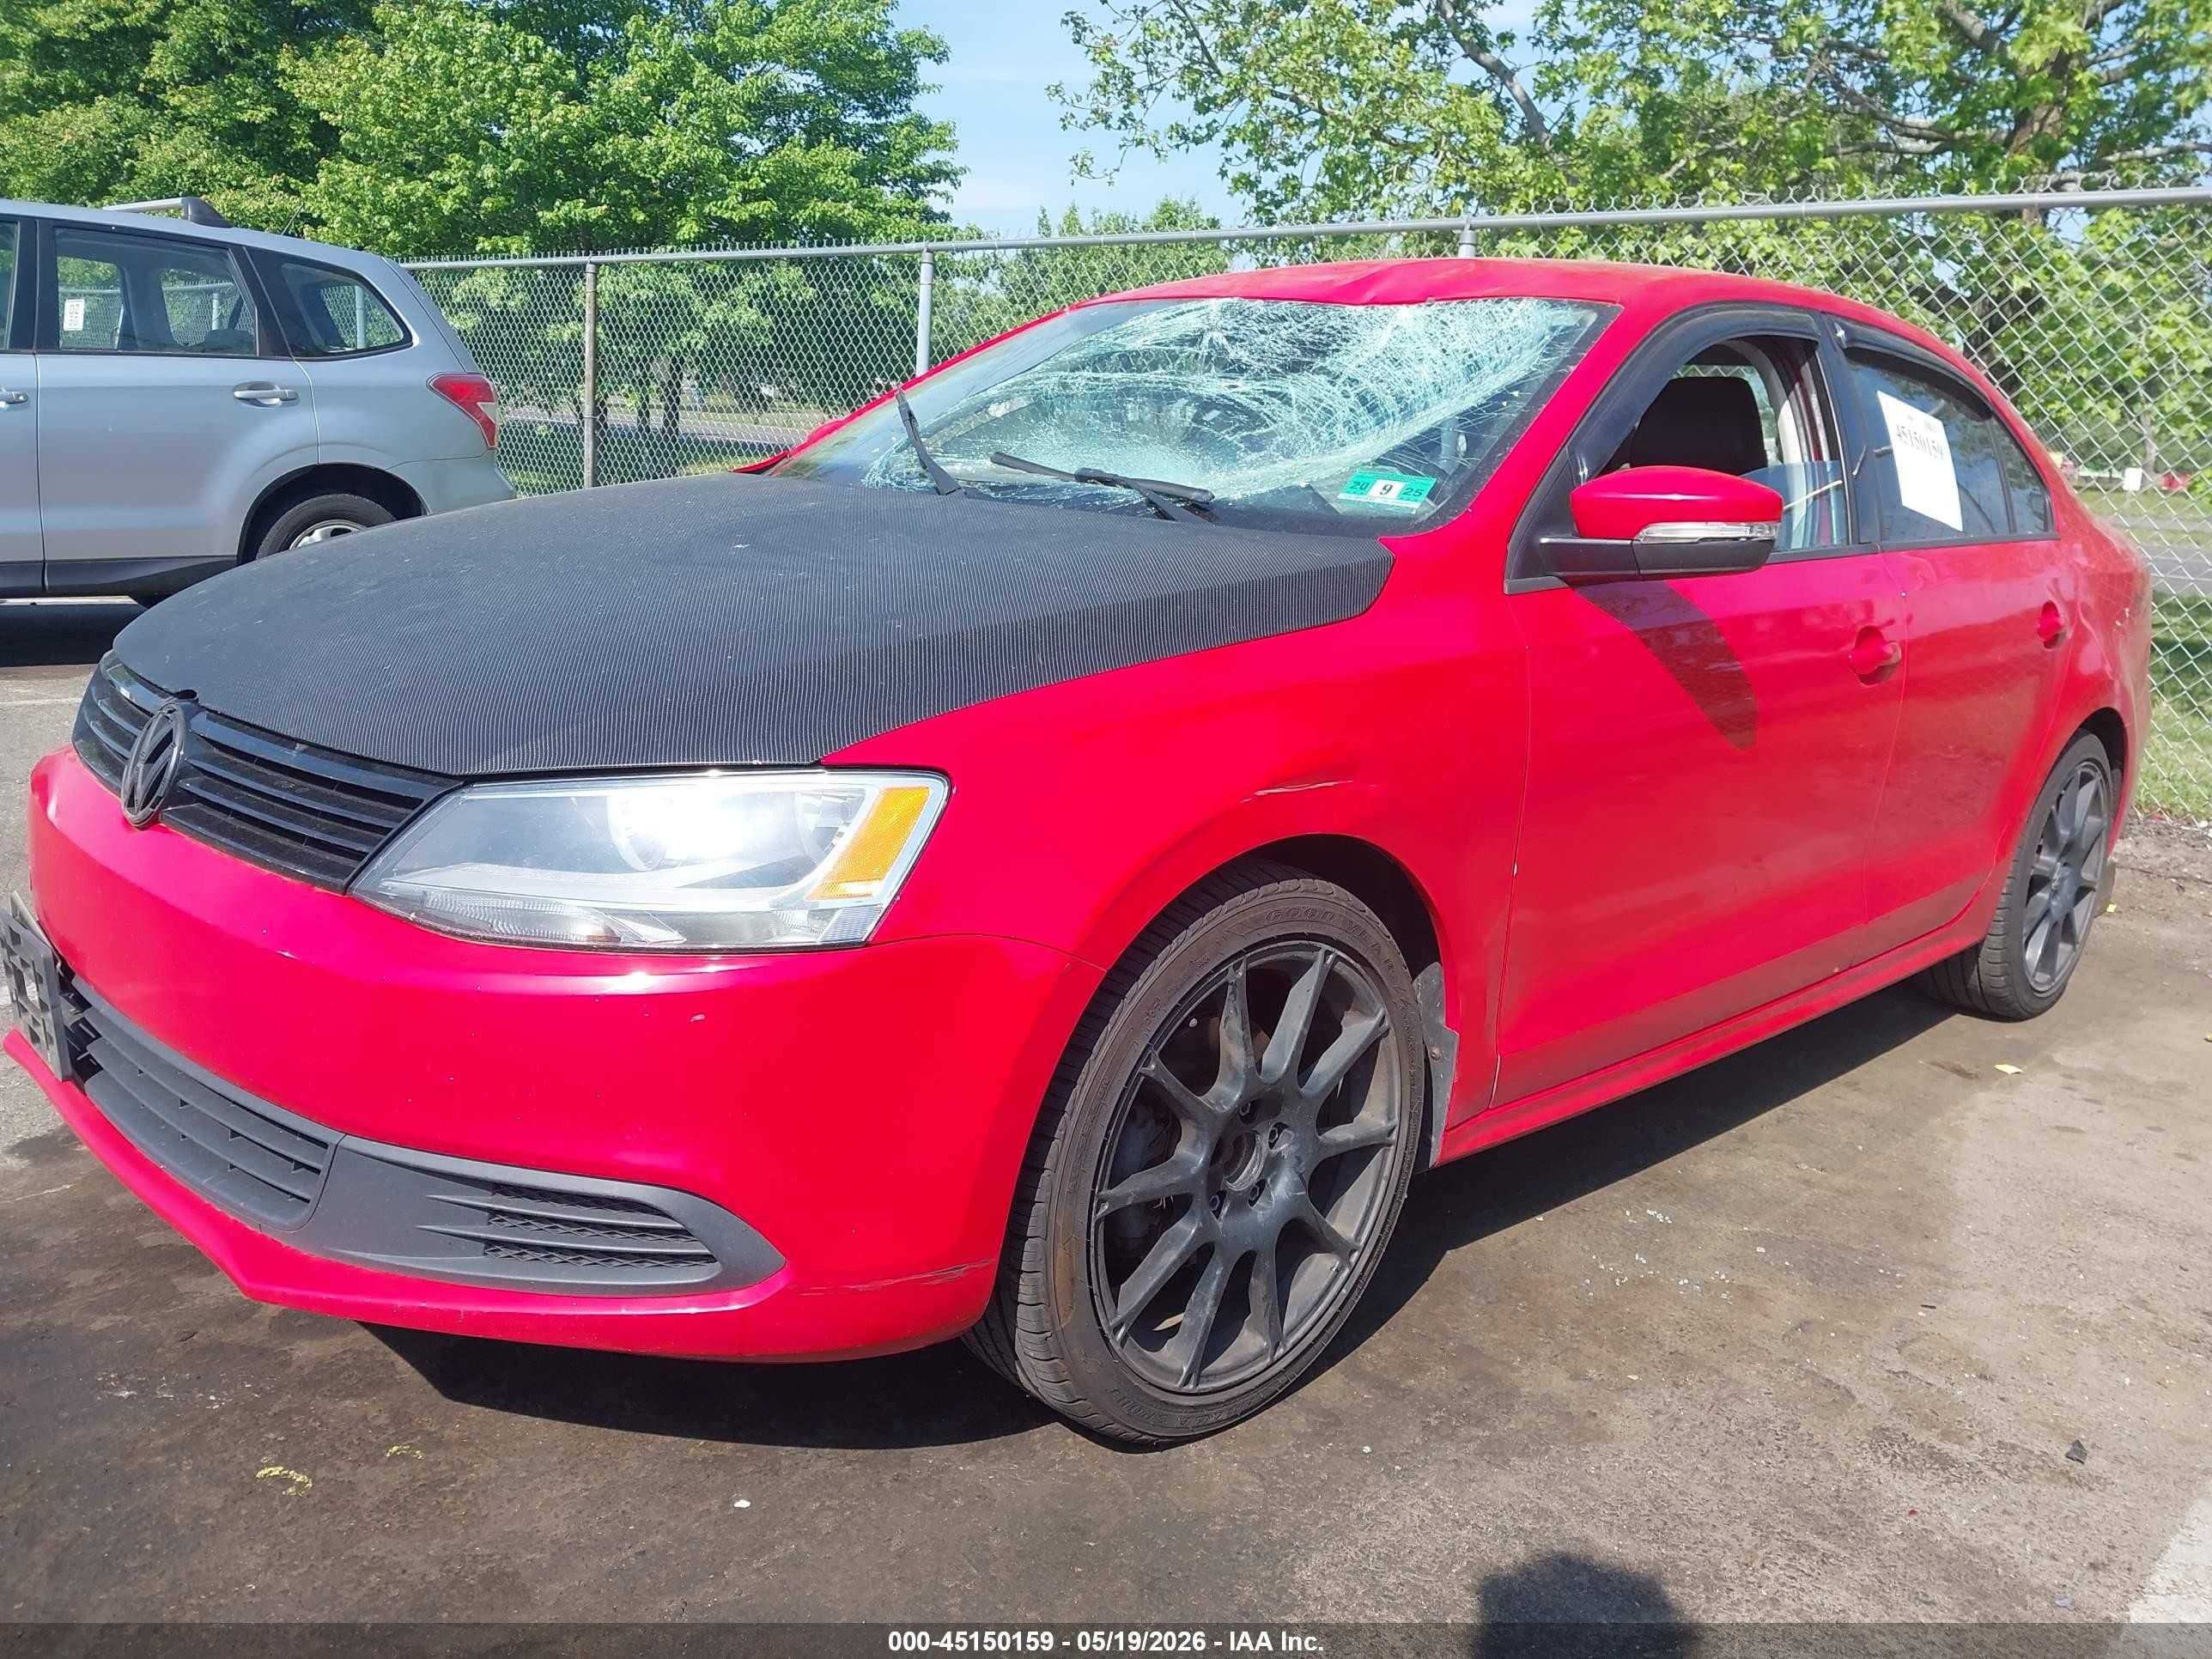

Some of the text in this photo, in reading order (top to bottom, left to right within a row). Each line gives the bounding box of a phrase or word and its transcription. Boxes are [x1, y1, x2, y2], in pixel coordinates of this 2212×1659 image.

[1350, 481, 1425, 496] 20 9 25
